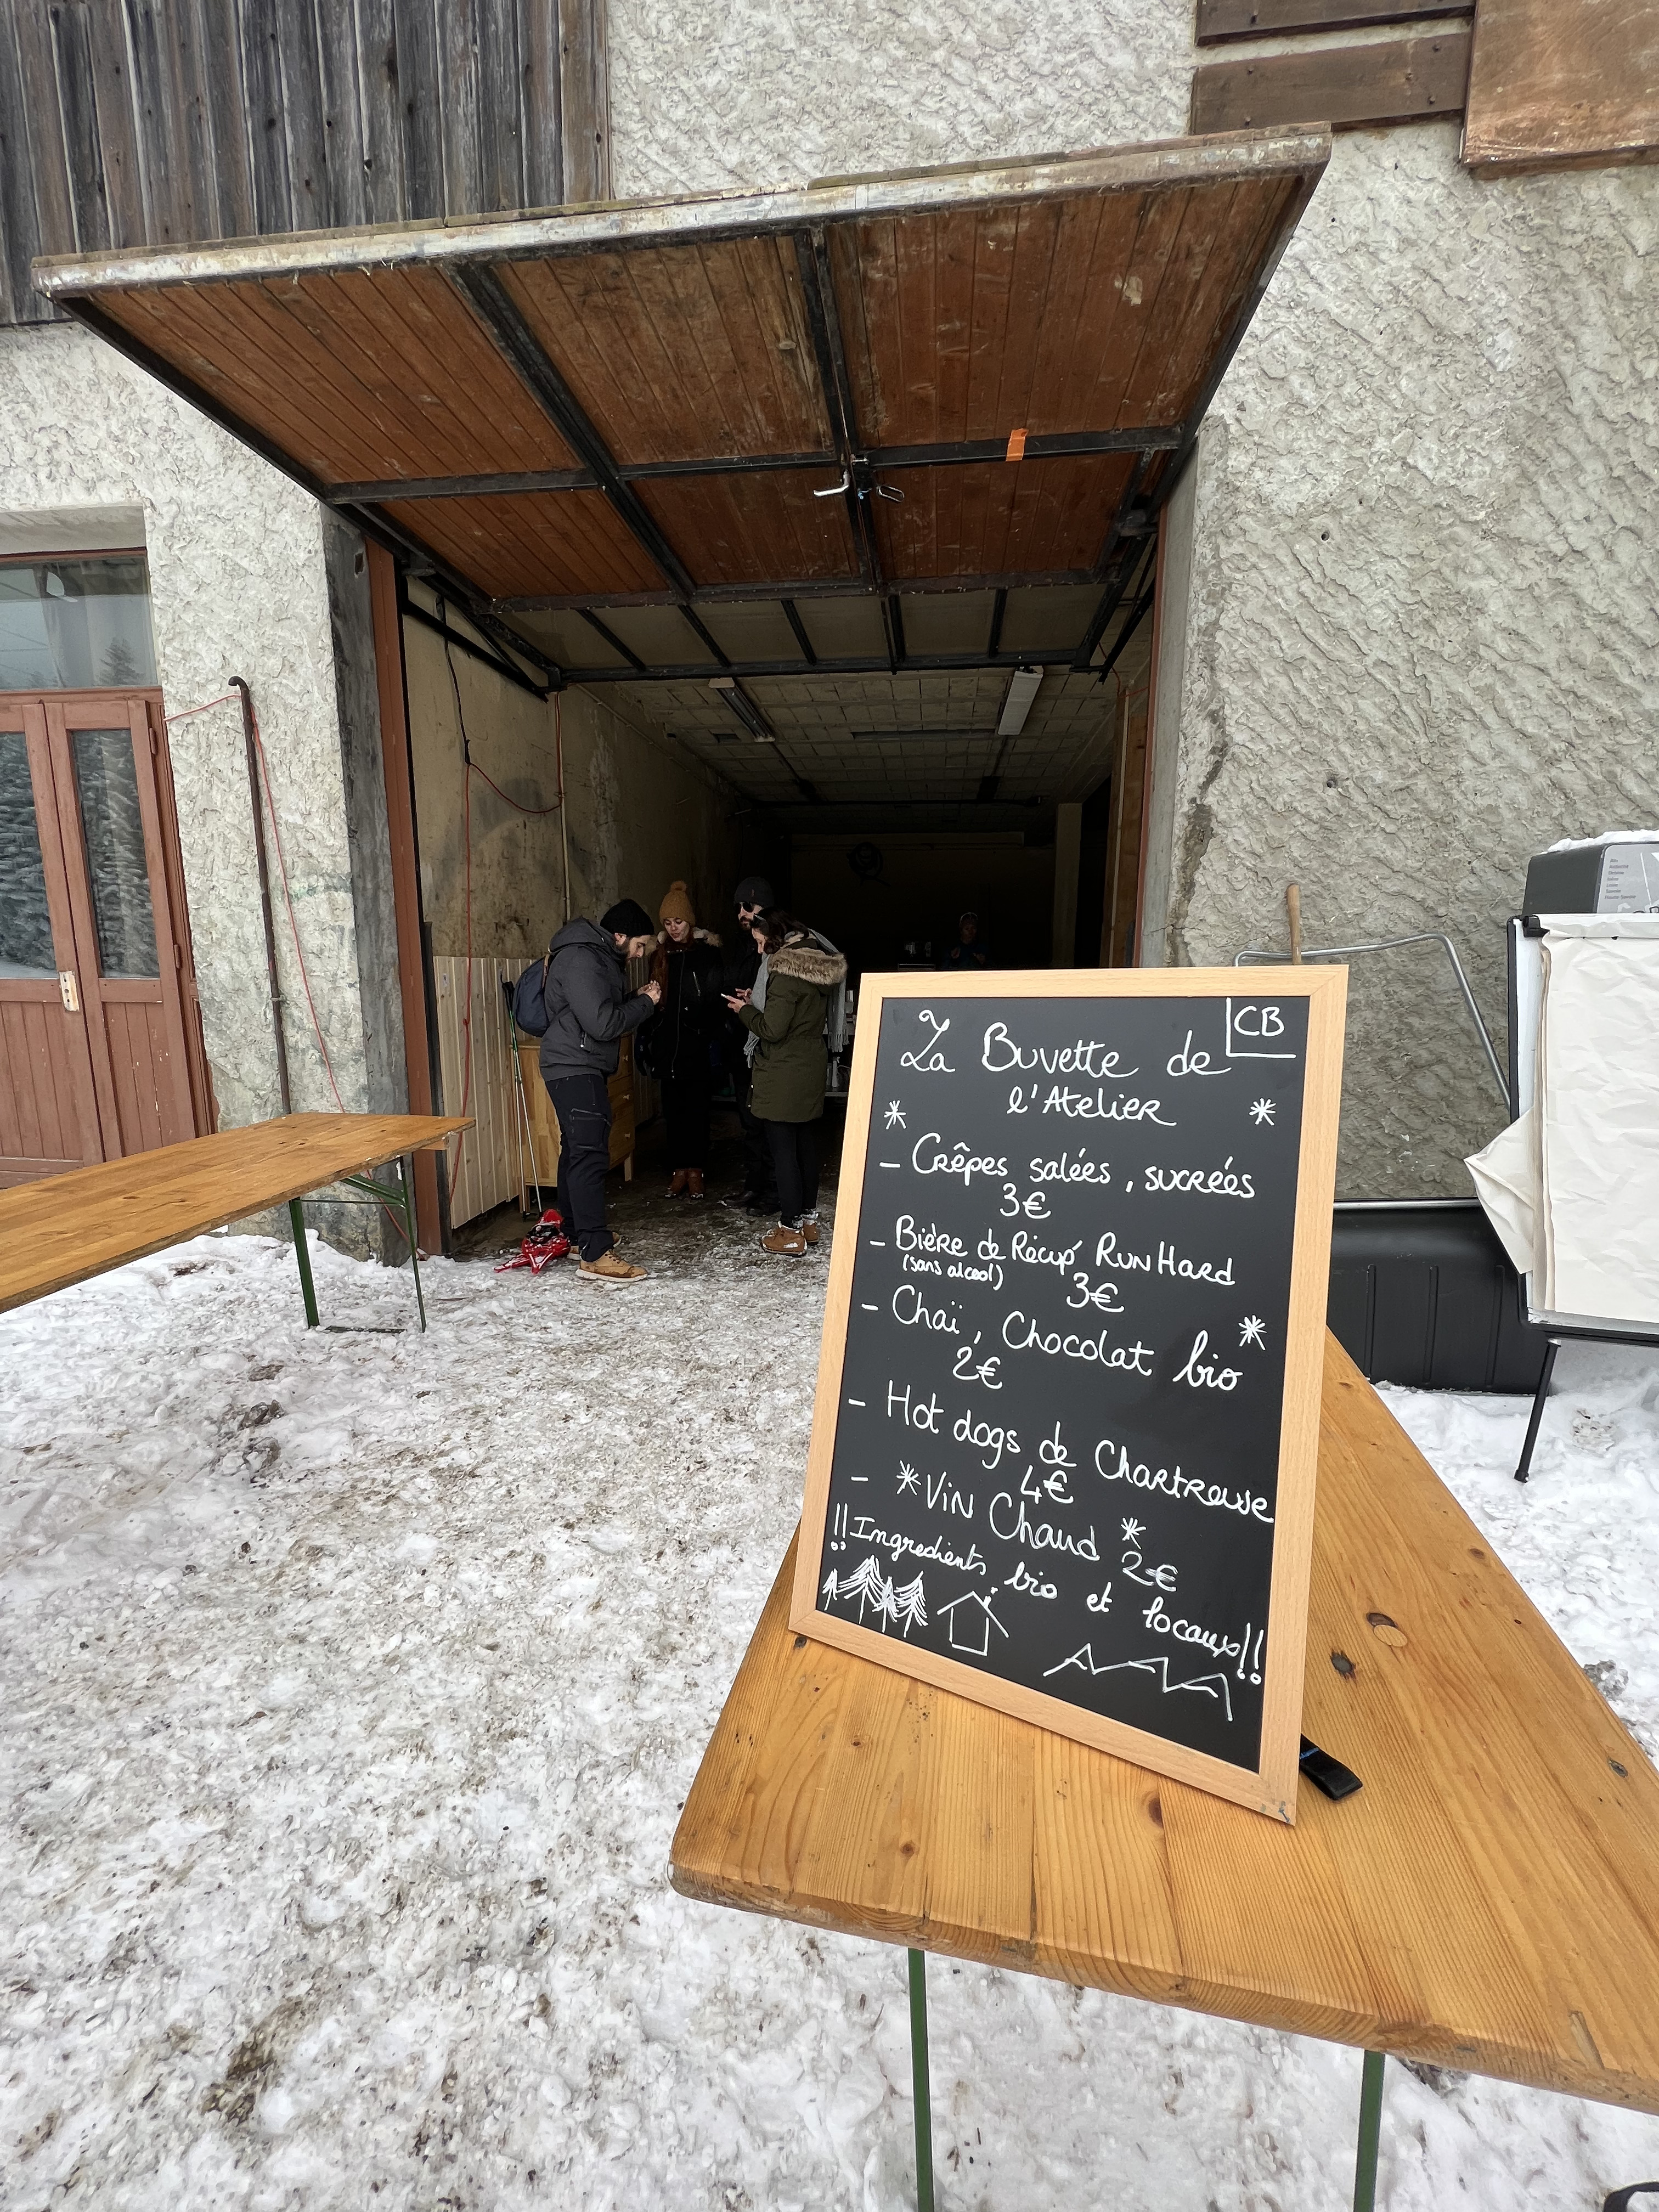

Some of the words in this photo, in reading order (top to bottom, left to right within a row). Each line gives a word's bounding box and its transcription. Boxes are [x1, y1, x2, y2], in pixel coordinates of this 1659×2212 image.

[1234, 1006, 1284, 1036] CB
[900, 1009, 955, 1072] La
[981, 1022, 1139, 1078] Buvette
[1166, 1030, 1232, 1076] de
[1007, 1084, 1177, 1126] l'Atelier
[912, 1132, 1008, 1186] Crêpes
[1000, 1183, 1051, 1219] 3€
[895, 1215, 968, 1255] Bière
[978, 1228, 1006, 1260] de
[903, 1254, 942, 1275] (sans
[947, 1262, 1003, 1290] alcool)
[1066, 1272, 1124, 1312] 3€
[953, 1346, 1002, 1389] 2€
[1002, 1311, 1154, 1376] Chocolat
[1173, 1331, 1243, 1391] bio
[888, 1380, 944, 1434] Hot
[953, 1413, 1020, 1469] dogs
[1039, 1421, 1076, 1467] de
[1095, 1440, 1274, 1523] Chartreuse
[1020, 1465, 1074, 1504] 4€
[989, 1493, 1100, 1561] Chaud
[1121, 1551, 1178, 1592] 2€
[1004, 1561, 1057, 1599] bio
[1087, 1582, 1112, 1612] et
